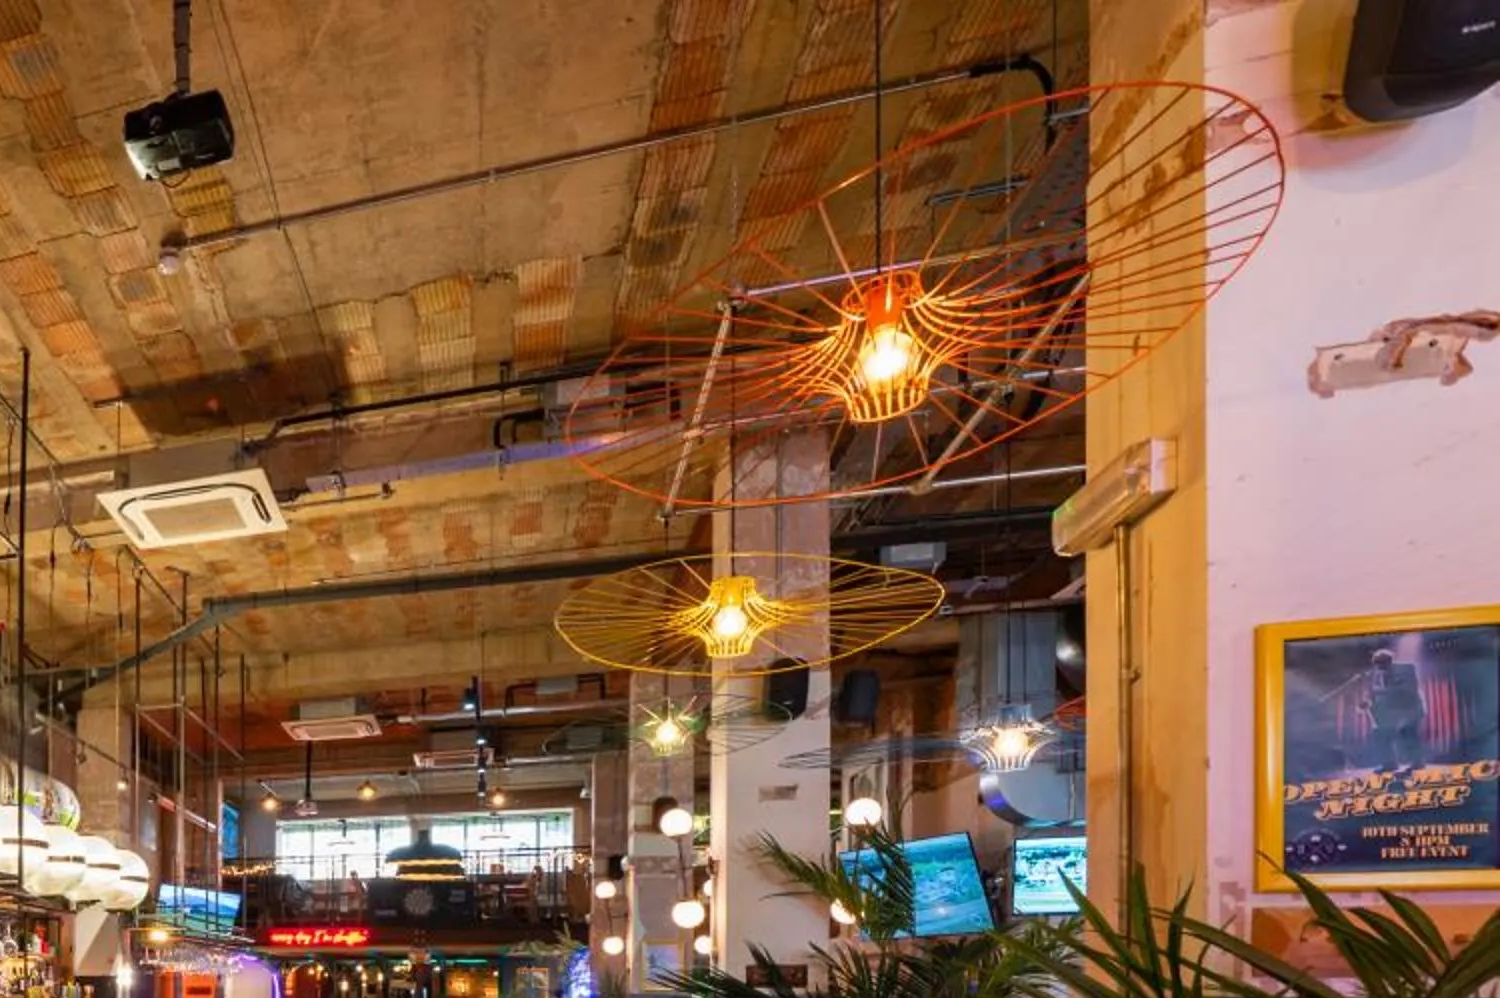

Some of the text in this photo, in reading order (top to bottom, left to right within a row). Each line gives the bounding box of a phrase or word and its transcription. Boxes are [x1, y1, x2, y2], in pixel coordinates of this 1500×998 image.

[1284, 759, 1499, 803] OPEN MIC
[1313, 785, 1471, 820] NIGHT
